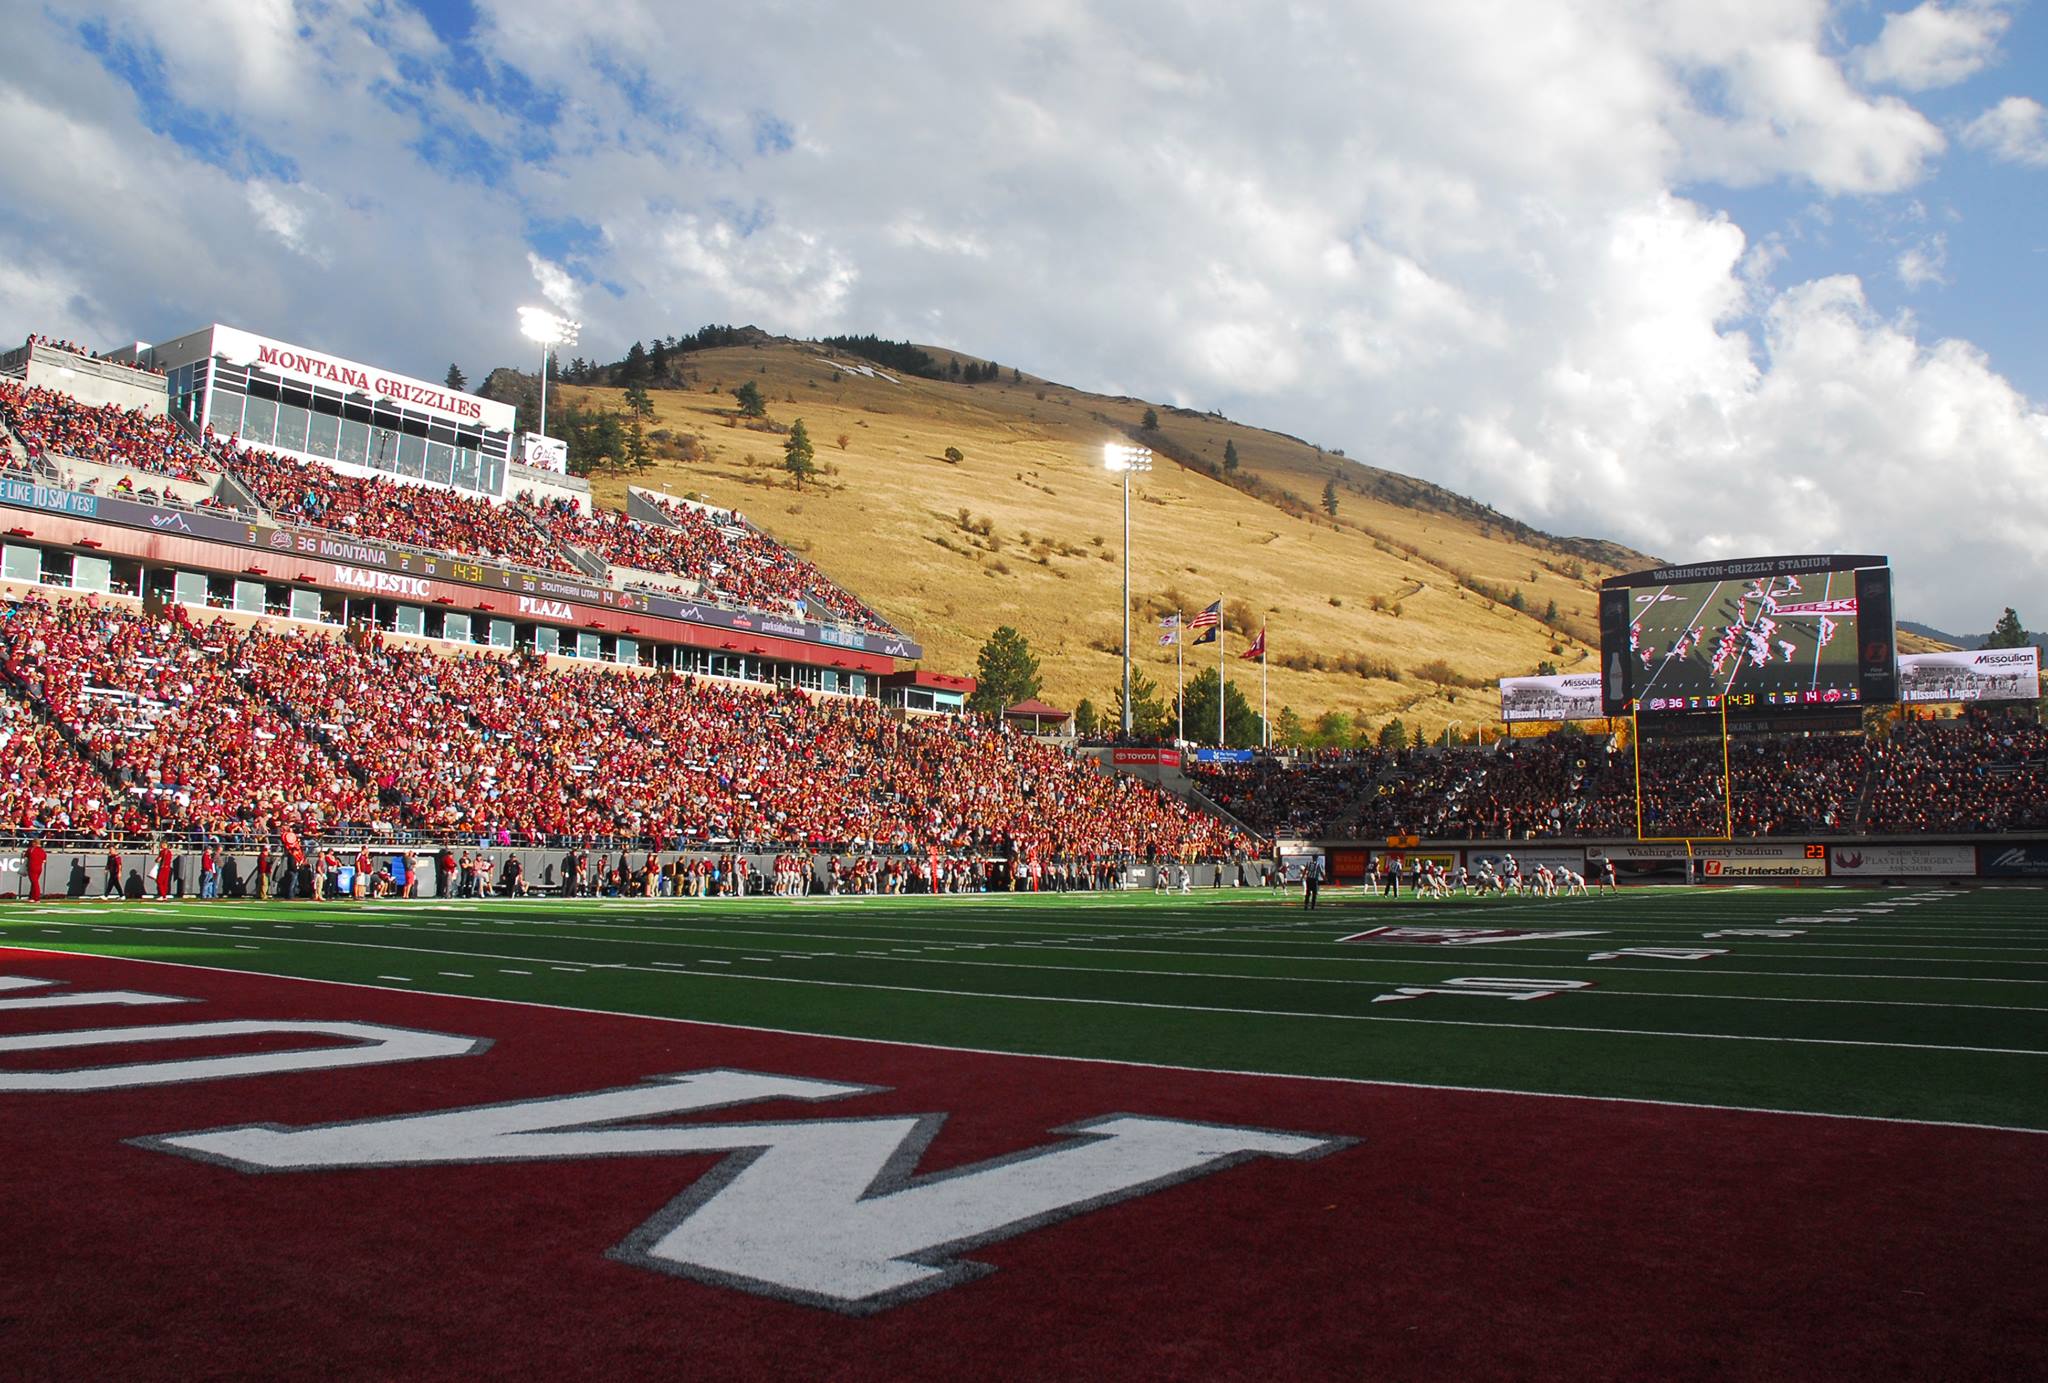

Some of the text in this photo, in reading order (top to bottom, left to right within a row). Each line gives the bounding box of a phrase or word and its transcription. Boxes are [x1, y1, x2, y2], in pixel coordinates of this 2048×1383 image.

[258, 344, 481, 419] MONTANA GRIZZLIES
[7, 482, 31, 502] LIKE
[33, 485, 48, 507] TO
[48, 489, 70, 510] SAY
[71, 495, 94, 513] YES!
[248, 531, 257, 543] 3
[297, 536, 387, 565] 36 MONTANA
[401, 559, 408, 570] 2
[425, 563, 435, 574] 10
[1653, 557, 1831, 580] WASHINGTON-GRIZZLY STADIUM
[453, 564, 482, 581] 14:31
[502, 577, 510, 587] 4
[523, 581, 535, 592] 30
[334, 565, 574, 620] MAJESTIC PLAZA
[541, 581, 613, 604] SOUTHERN UTAH 14
[1974, 653, 2034, 665] Missoulian
[1728, 694, 1754, 706] 14:31
[1769, 696, 1775, 704] 4
[1785, 695, 1796, 704] 30
[1806, 692, 1817, 702] 14
[1903, 689, 1982, 700] A Missoula Legacy
[1669, 698, 1683, 708] 36
[1692, 700, 1698, 708] 2
[1509, 709, 1540, 719] Missoula
[1541, 708, 1566, 719] Legacy
[1694, 847, 1733, 858] Grizzly
[1735, 847, 1783, 856] Stadium
[1806, 845, 1824, 858] 23
[1722, 866, 1823, 876] First Interstate Bank
